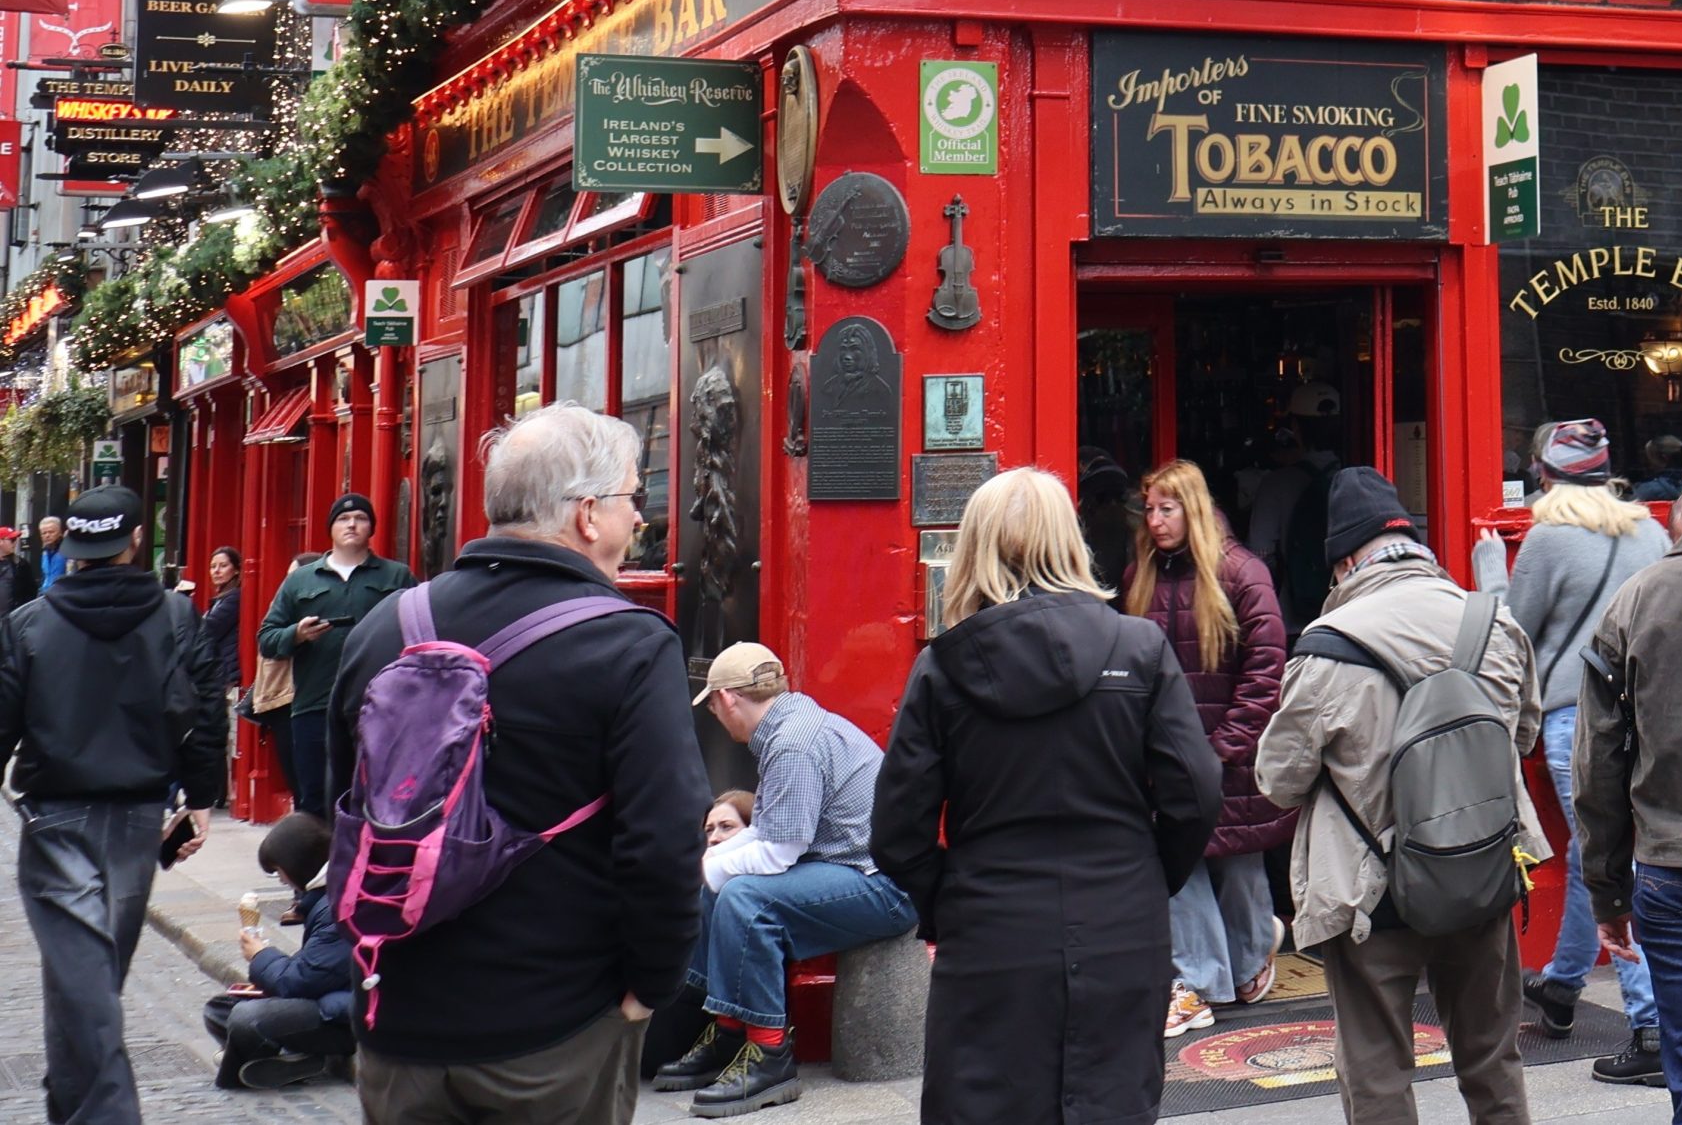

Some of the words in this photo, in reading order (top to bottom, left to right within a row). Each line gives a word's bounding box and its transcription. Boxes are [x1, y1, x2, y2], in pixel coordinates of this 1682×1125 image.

[147, 0, 192, 13] BEER
[149, 60, 196, 74] LIVE
[46, 81, 80, 94] THE
[85, 81, 134, 96] TEMP
[175, 79, 235, 93] DAILY
[589, 78, 611, 96] The
[612, 72, 688, 107] Whiskey
[691, 79, 754, 107] Reserve
[1107, 54, 1249, 111] Importers
[1198, 89, 1222, 105] OF
[56, 99, 133, 121] WHISKEY
[1236, 103, 1287, 125] FINE
[1292, 104, 1396, 128] SMOKING
[469, 101, 515, 160] THE
[602, 118, 686, 132] IRELAND'S
[67, 127, 163, 142] DISTILLERY
[609, 132, 678, 146] LARGEST
[937, 138, 982, 150] Official
[87, 152, 142, 164] STORE
[607, 145, 681, 159] WHISKEY
[934, 151, 986, 162] Member
[1146, 112, 1398, 204] TOBACCO
[594, 159, 693, 174] COLLECTION
[1201, 191, 1296, 213] Always
[1311, 193, 1333, 211] in
[1345, 191, 1418, 213] Stock
[1599, 206, 1649, 228] THE
[1509, 245, 1657, 321] TEMPLE
[1588, 296, 1621, 311] Estd.
[1625, 296, 1654, 311] 1840
